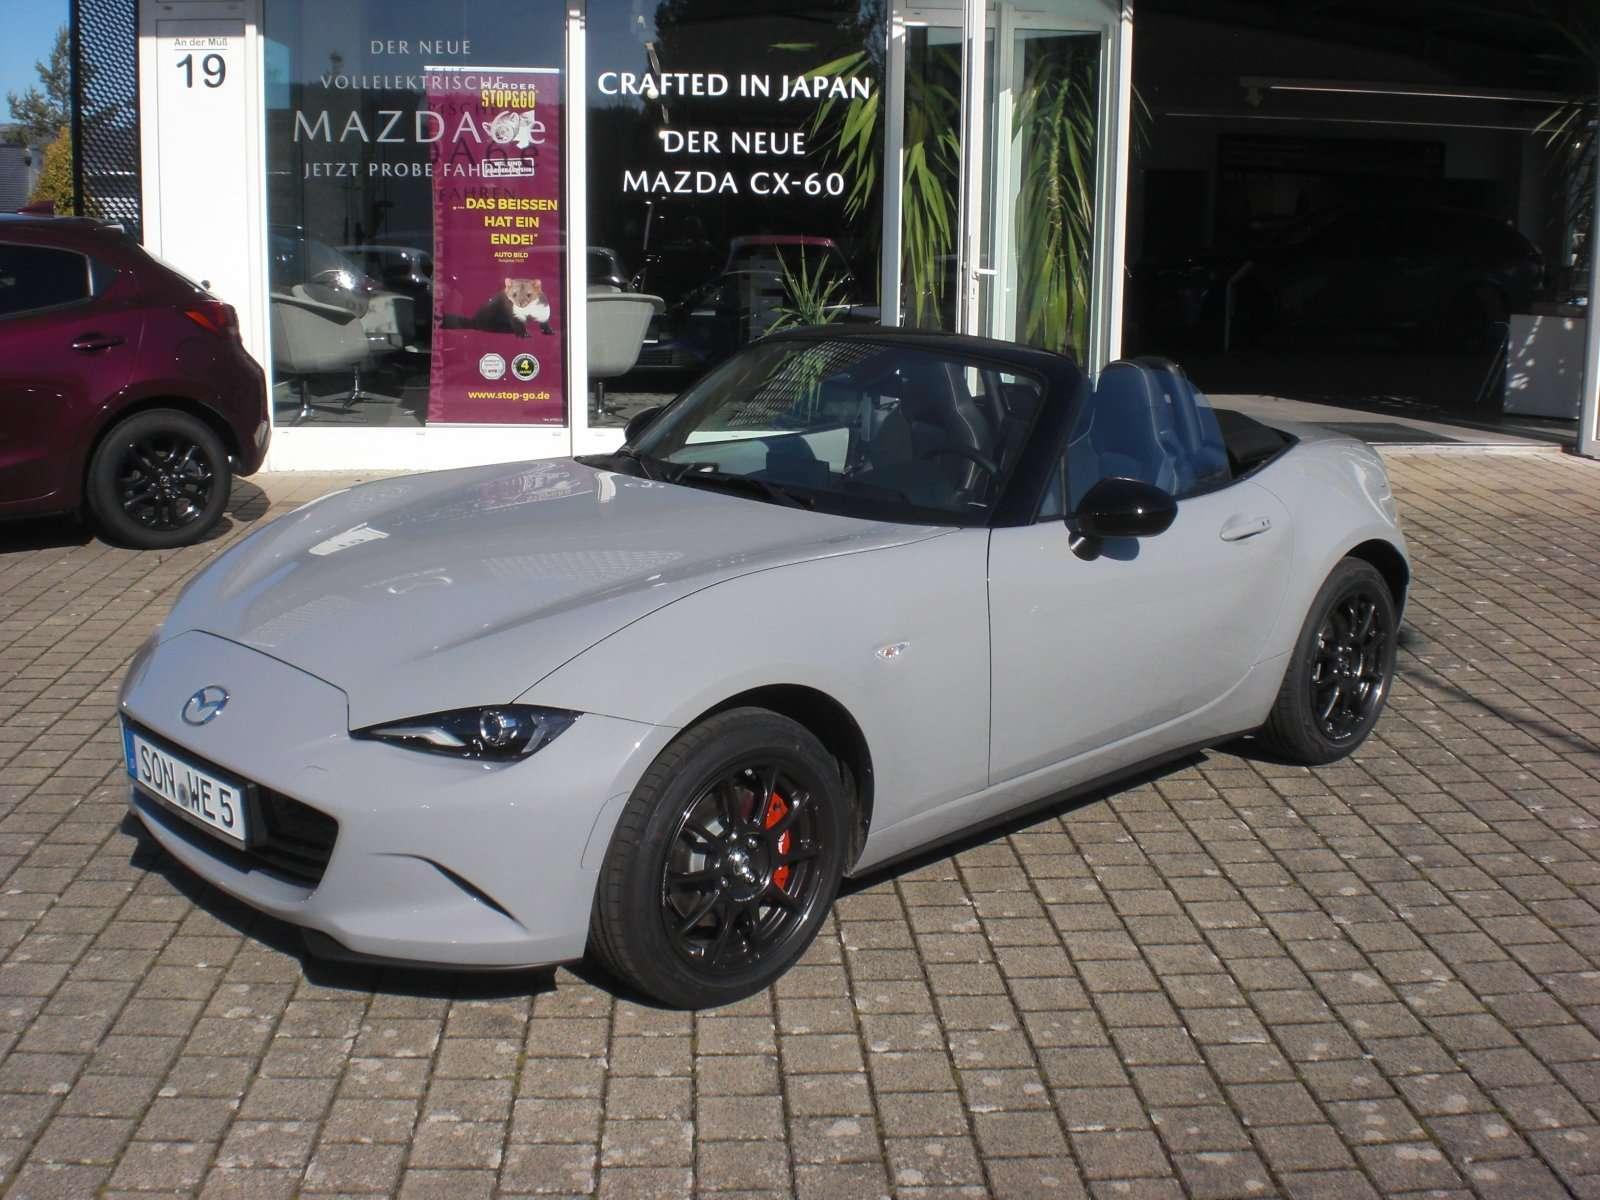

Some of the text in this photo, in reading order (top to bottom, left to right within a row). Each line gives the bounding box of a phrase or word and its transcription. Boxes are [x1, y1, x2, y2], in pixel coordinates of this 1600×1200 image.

[174, 38, 187, 46] An
[190, 38, 206, 46] der
[371, 40, 473, 55] DER NEUE
[176, 53, 226, 88] 19
[320, 75, 504, 91] VOLLELEKTRISCHE
[598, 72, 870, 101] CRAFTED IN JAPAN
[662, 131, 806, 155] DER NEUE
[304, 163, 360, 179] JETZT
[369, 163, 433, 178] PROBE
[623, 170, 845, 196] MAZDA CX-60
[498, 199, 558, 211] BEISSEN
[484, 215, 540, 228] HAT EIN
[494, 251, 529, 259] AUTO BILD
[520, 359, 530, 371] 4
[467, 391, 551, 402] www.stop-go.de
[140, 744, 177, 799] SON
[219, 787, 235, 829] 5
